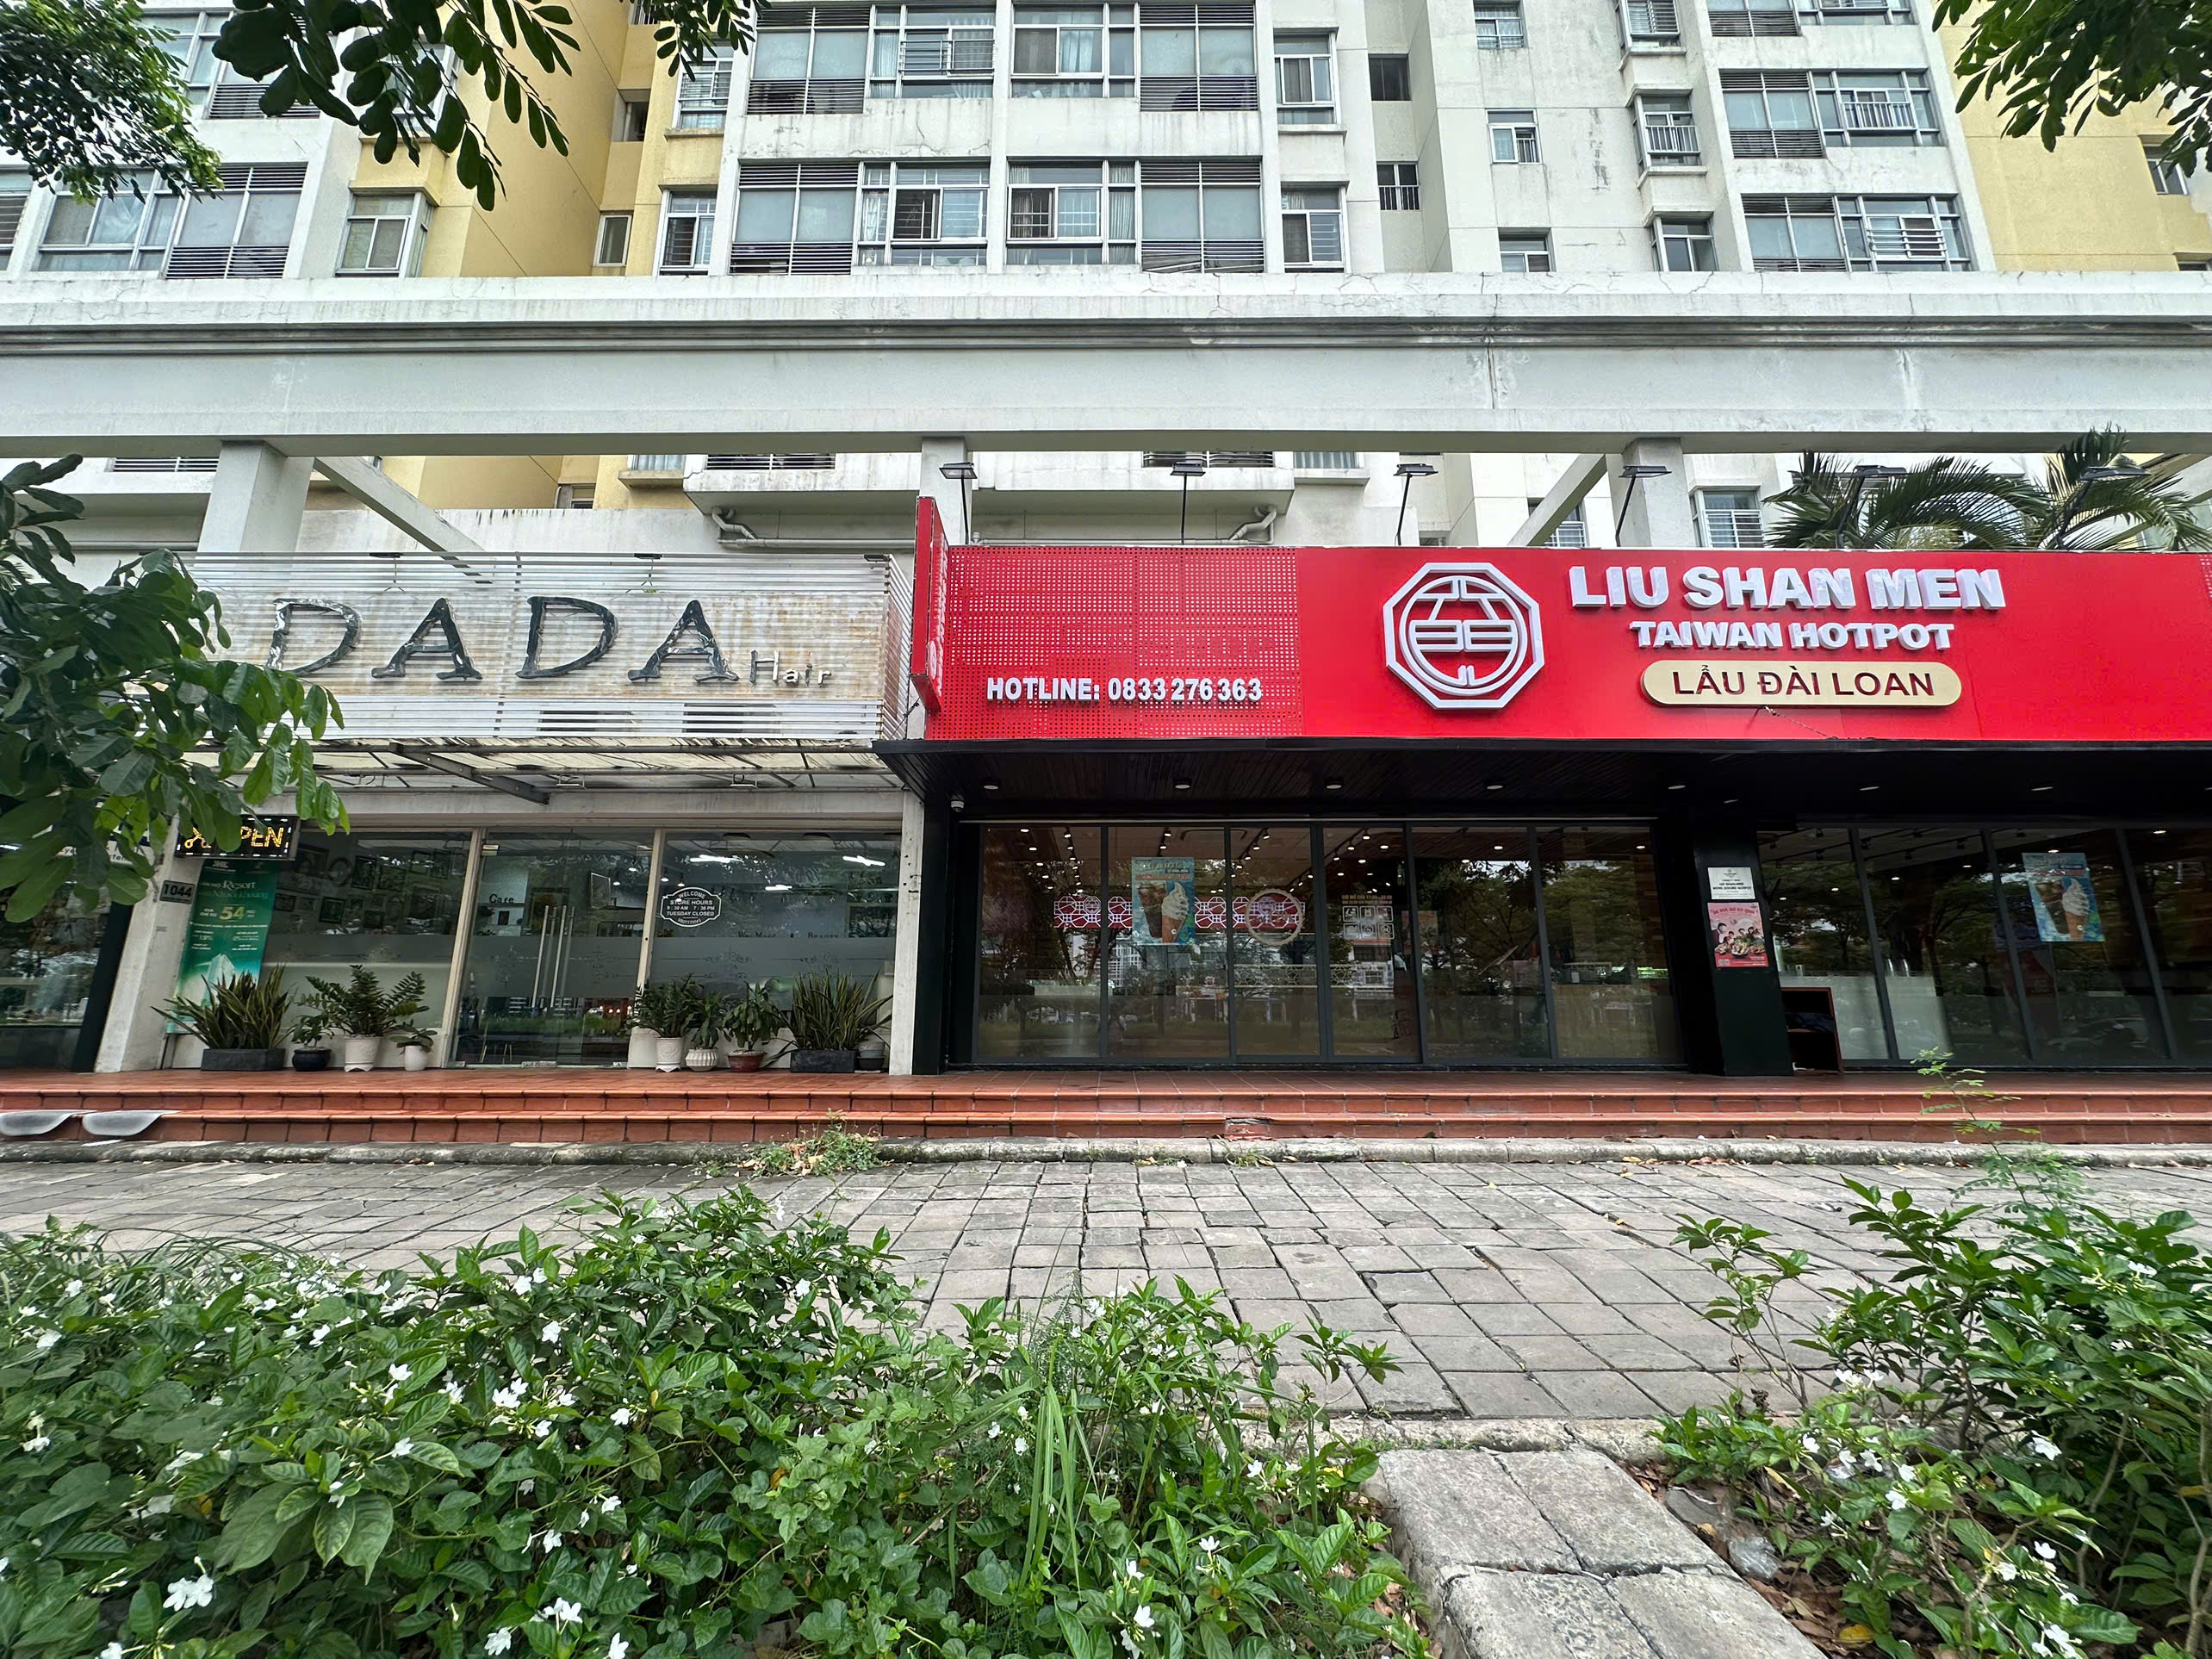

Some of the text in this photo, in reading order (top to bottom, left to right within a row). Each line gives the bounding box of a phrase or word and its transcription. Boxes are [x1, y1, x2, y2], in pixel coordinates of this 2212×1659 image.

[1569, 566, 2006, 611] LIU SHAN MEN
[266, 596, 742, 683] DADA
[1629, 621, 1954, 651] TAIWAN HOTPOT
[749, 649, 833, 688] Hair
[1672, 664, 1935, 696] LẨU ĐÀI LOAN
[986, 677, 1100, 701] HOTLINE:
[239, 825, 285, 848] PEN
[164, 883, 192, 898] 1044
[222, 879, 256, 891] Resort
[678, 891, 706, 899] WELCOME
[221, 906, 245, 921] 54
